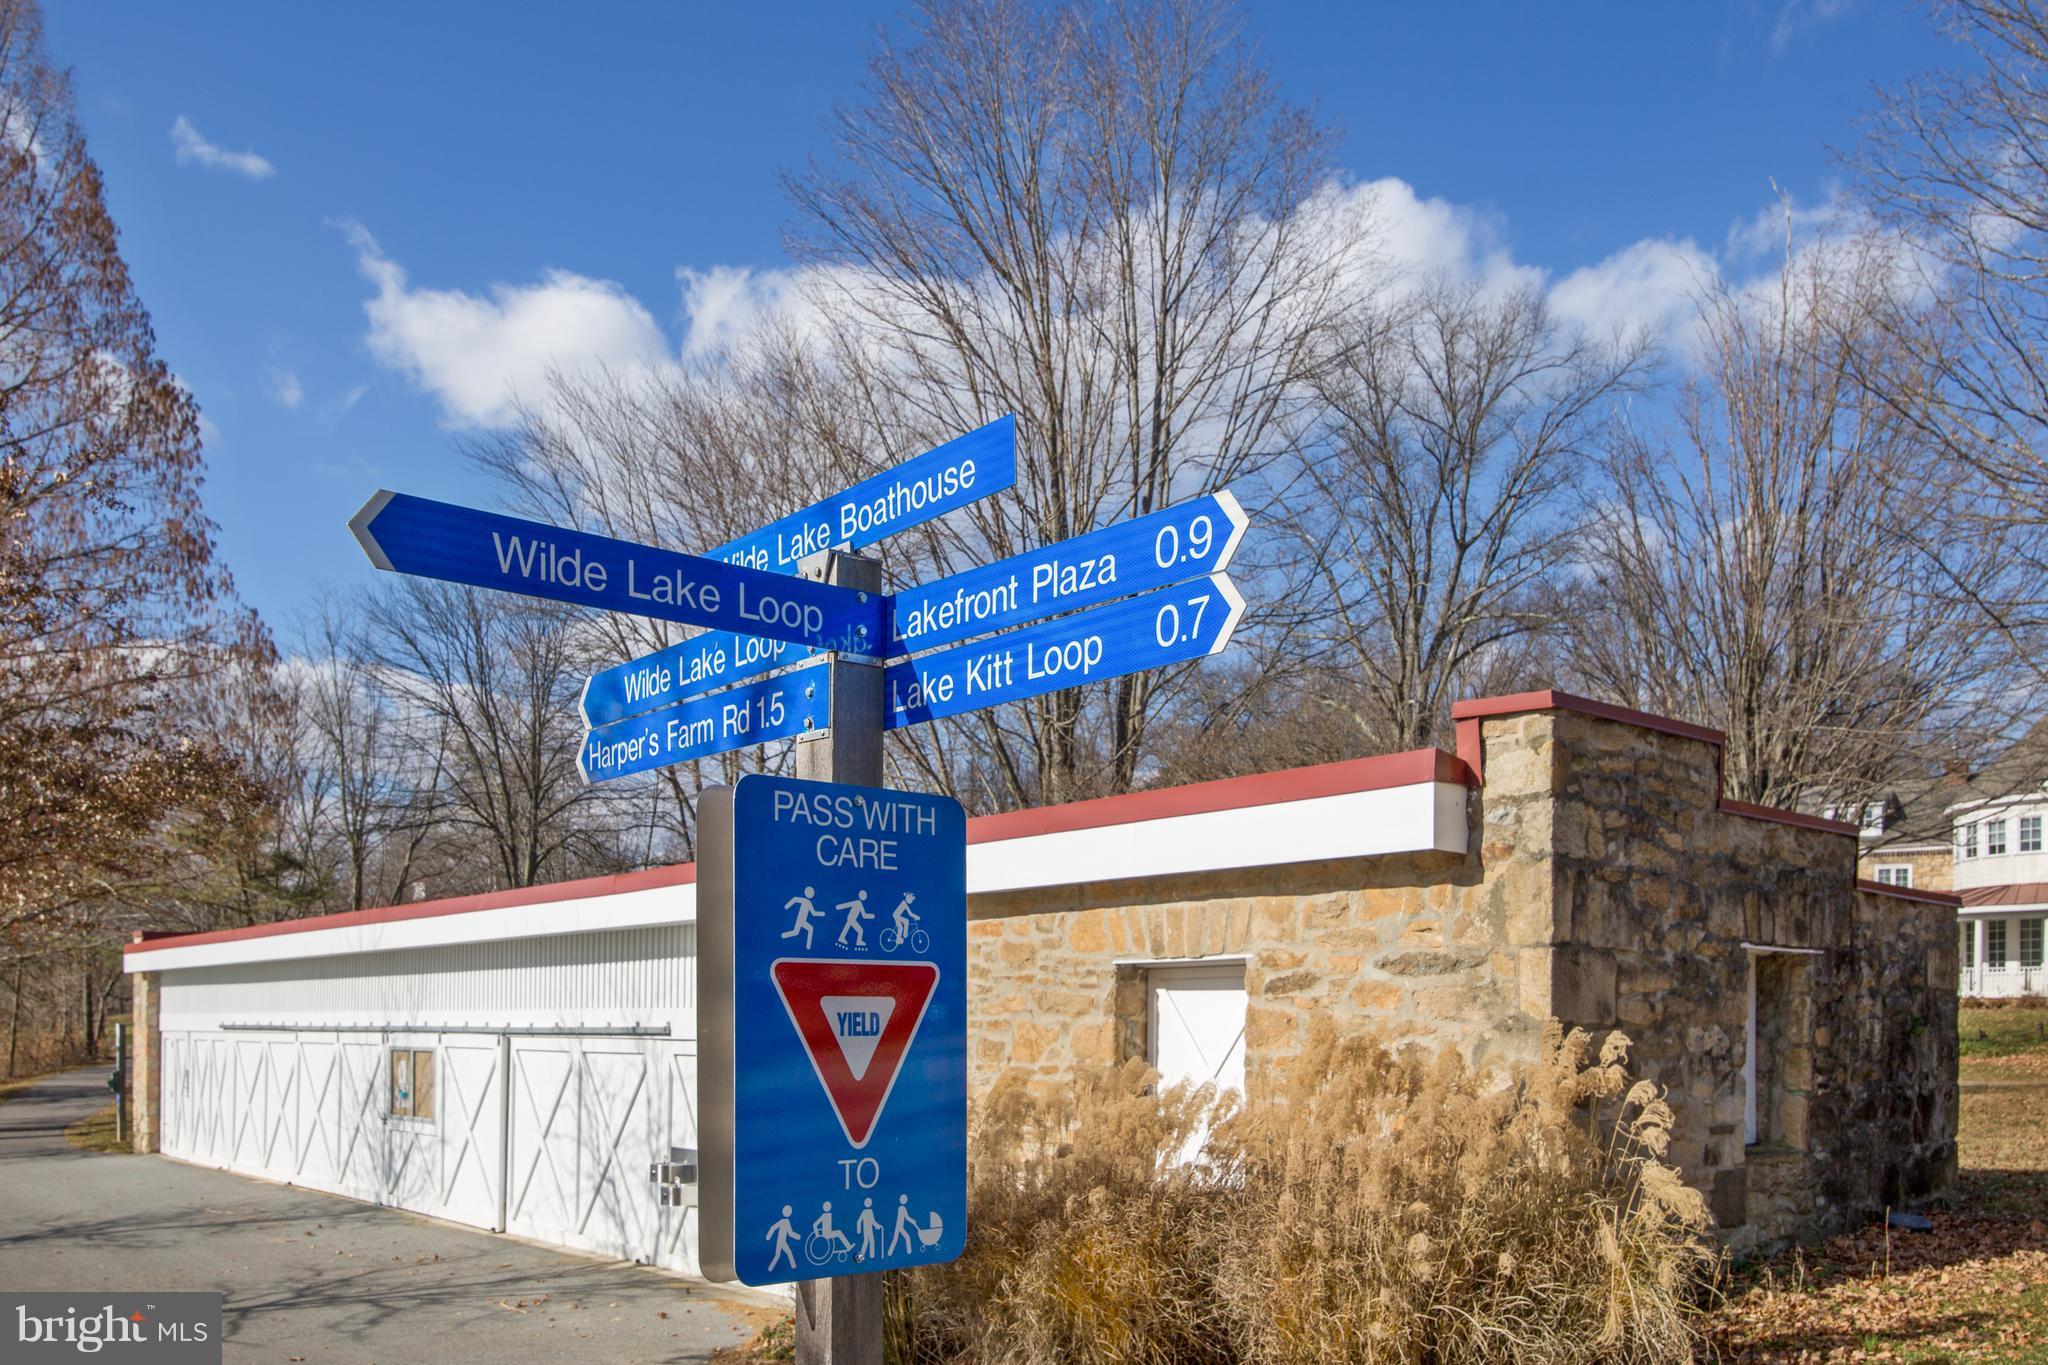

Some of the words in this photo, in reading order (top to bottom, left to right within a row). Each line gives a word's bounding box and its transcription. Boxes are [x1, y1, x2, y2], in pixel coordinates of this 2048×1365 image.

[723, 545, 769, 571] ilde
[778, 522, 831, 566] Lake
[841, 459, 976, 541] Boathouse
[492, 531, 608, 592] Wilde
[628, 559, 721, 613] Lake
[739, 582, 823, 638] Loop
[891, 574, 1018, 643] Lakefront
[1032, 553, 1117, 601] Plaza
[1155, 514, 1214, 570] 0.9
[624, 668, 671, 704] Wilde
[679, 647, 726, 688] Lake
[735, 635, 787, 668] Loop
[891, 672, 954, 714] Lake
[966, 649, 1013, 696] Kitt
[1027, 635, 1103, 681] Loop
[1155, 594, 1211, 648] 0.7
[588, 728, 660, 772] Harper's
[667, 719, 714, 752] Farm
[723, 700, 750, 738] Rd
[756, 691, 785, 729] 1.5
[774, 790, 854, 827] PASS
[861, 800, 936, 836] WITH
[816, 835, 899, 871] CARE
[836, 1011, 880, 1038] YIELD
[838, 1157, 880, 1190] TO
